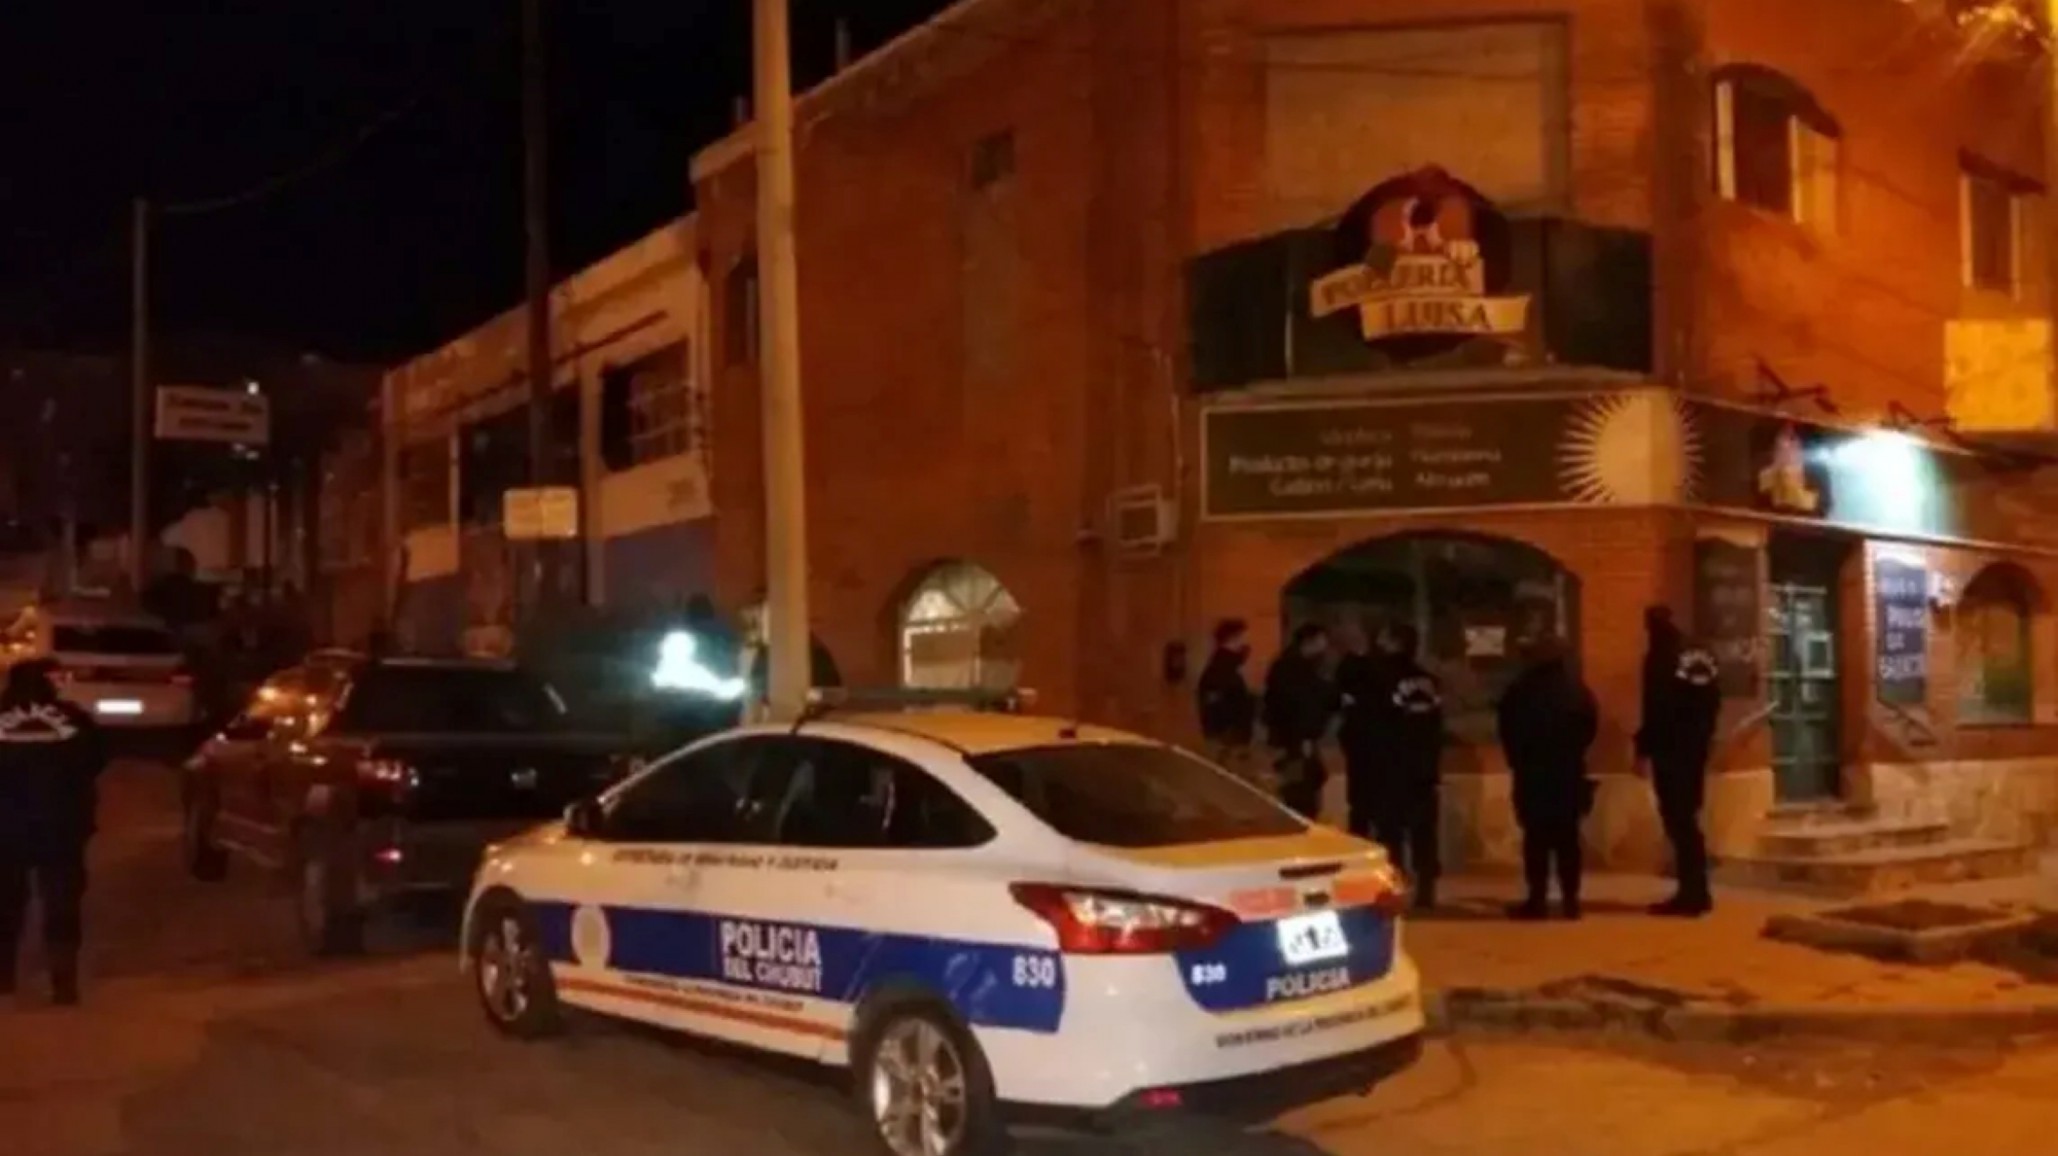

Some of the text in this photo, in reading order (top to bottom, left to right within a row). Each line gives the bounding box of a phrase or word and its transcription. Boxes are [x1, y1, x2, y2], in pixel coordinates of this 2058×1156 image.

[1384, 300, 1494, 331] LUISA
[720, 920, 820, 965] POLICIA
[723, 957, 821, 992] DEL CHUBUT
[1012, 956, 1055, 987] 830
[1191, 964, 1227, 985] 830
[1266, 966, 1350, 1001] POLICIA
